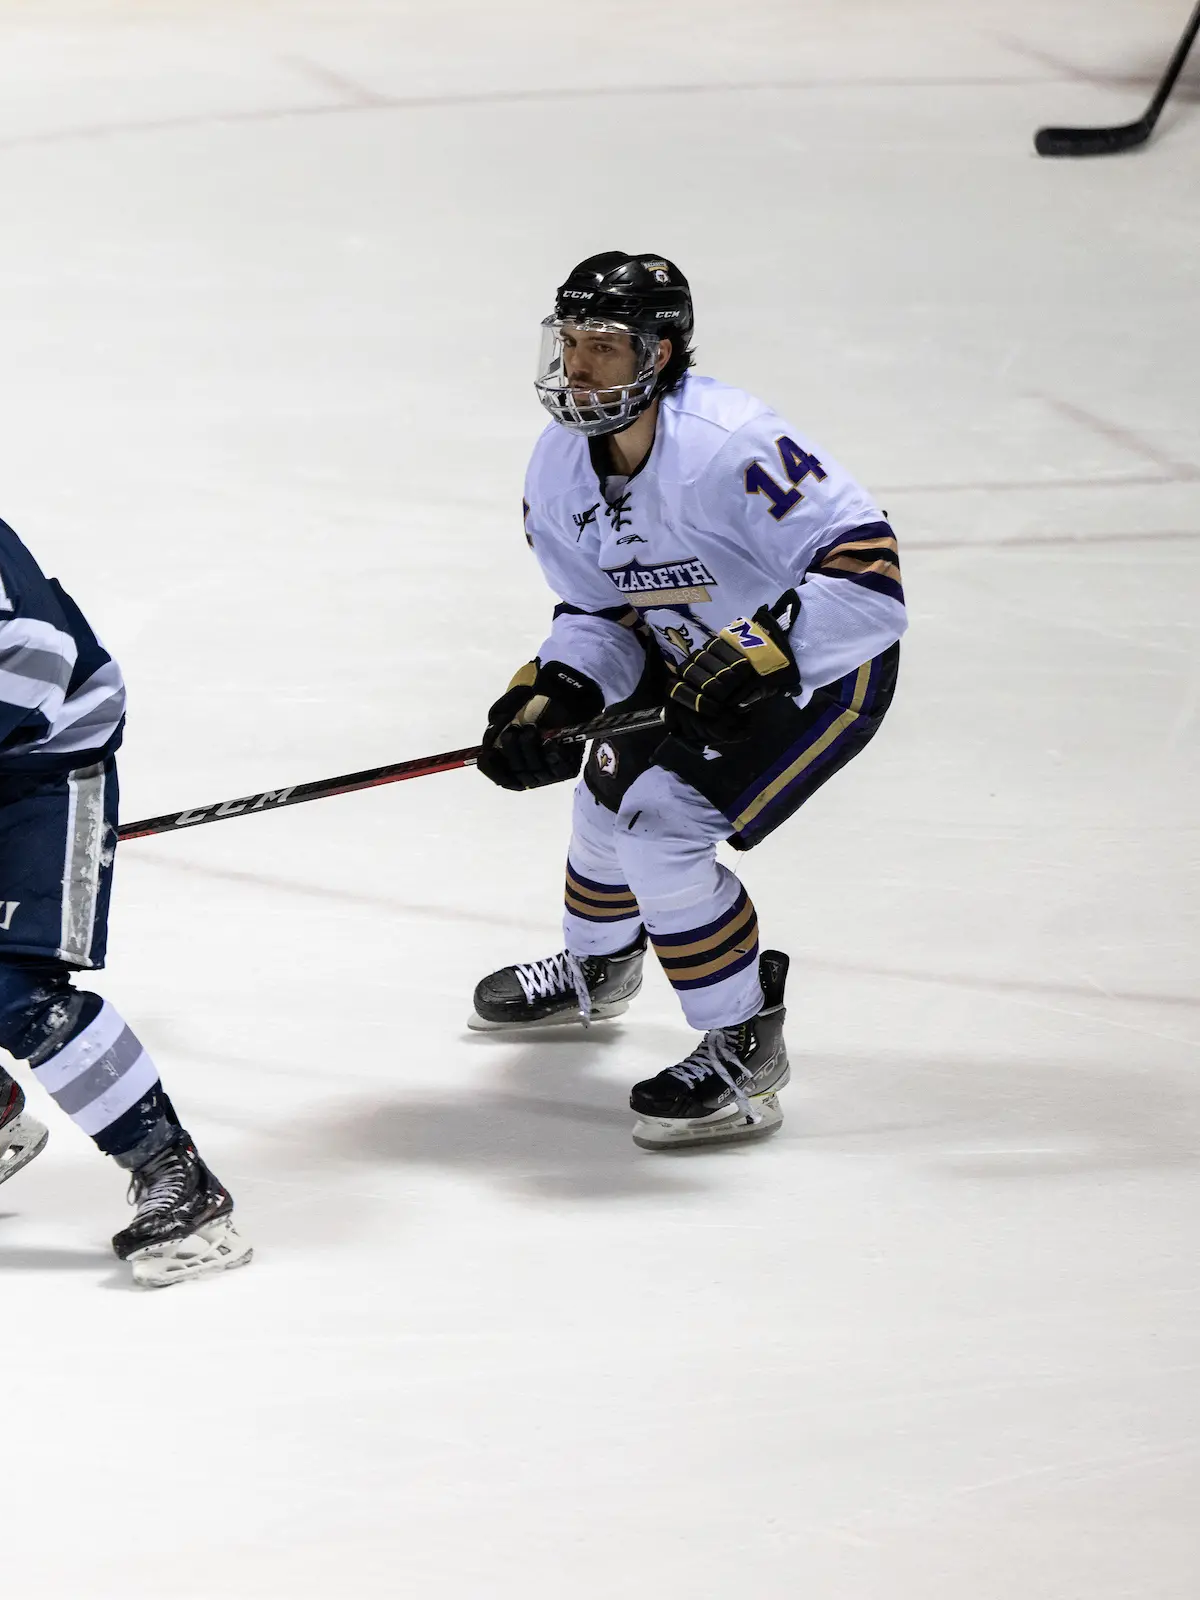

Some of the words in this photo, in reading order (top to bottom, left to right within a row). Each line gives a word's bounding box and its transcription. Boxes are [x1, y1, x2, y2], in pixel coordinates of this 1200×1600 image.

[562, 290, 594, 300] CCM
[655, 310, 680, 319] CCM
[744, 435, 828, 522] 14
[557, 672, 583, 689] CCM
[174, 785, 299, 826] CCM
